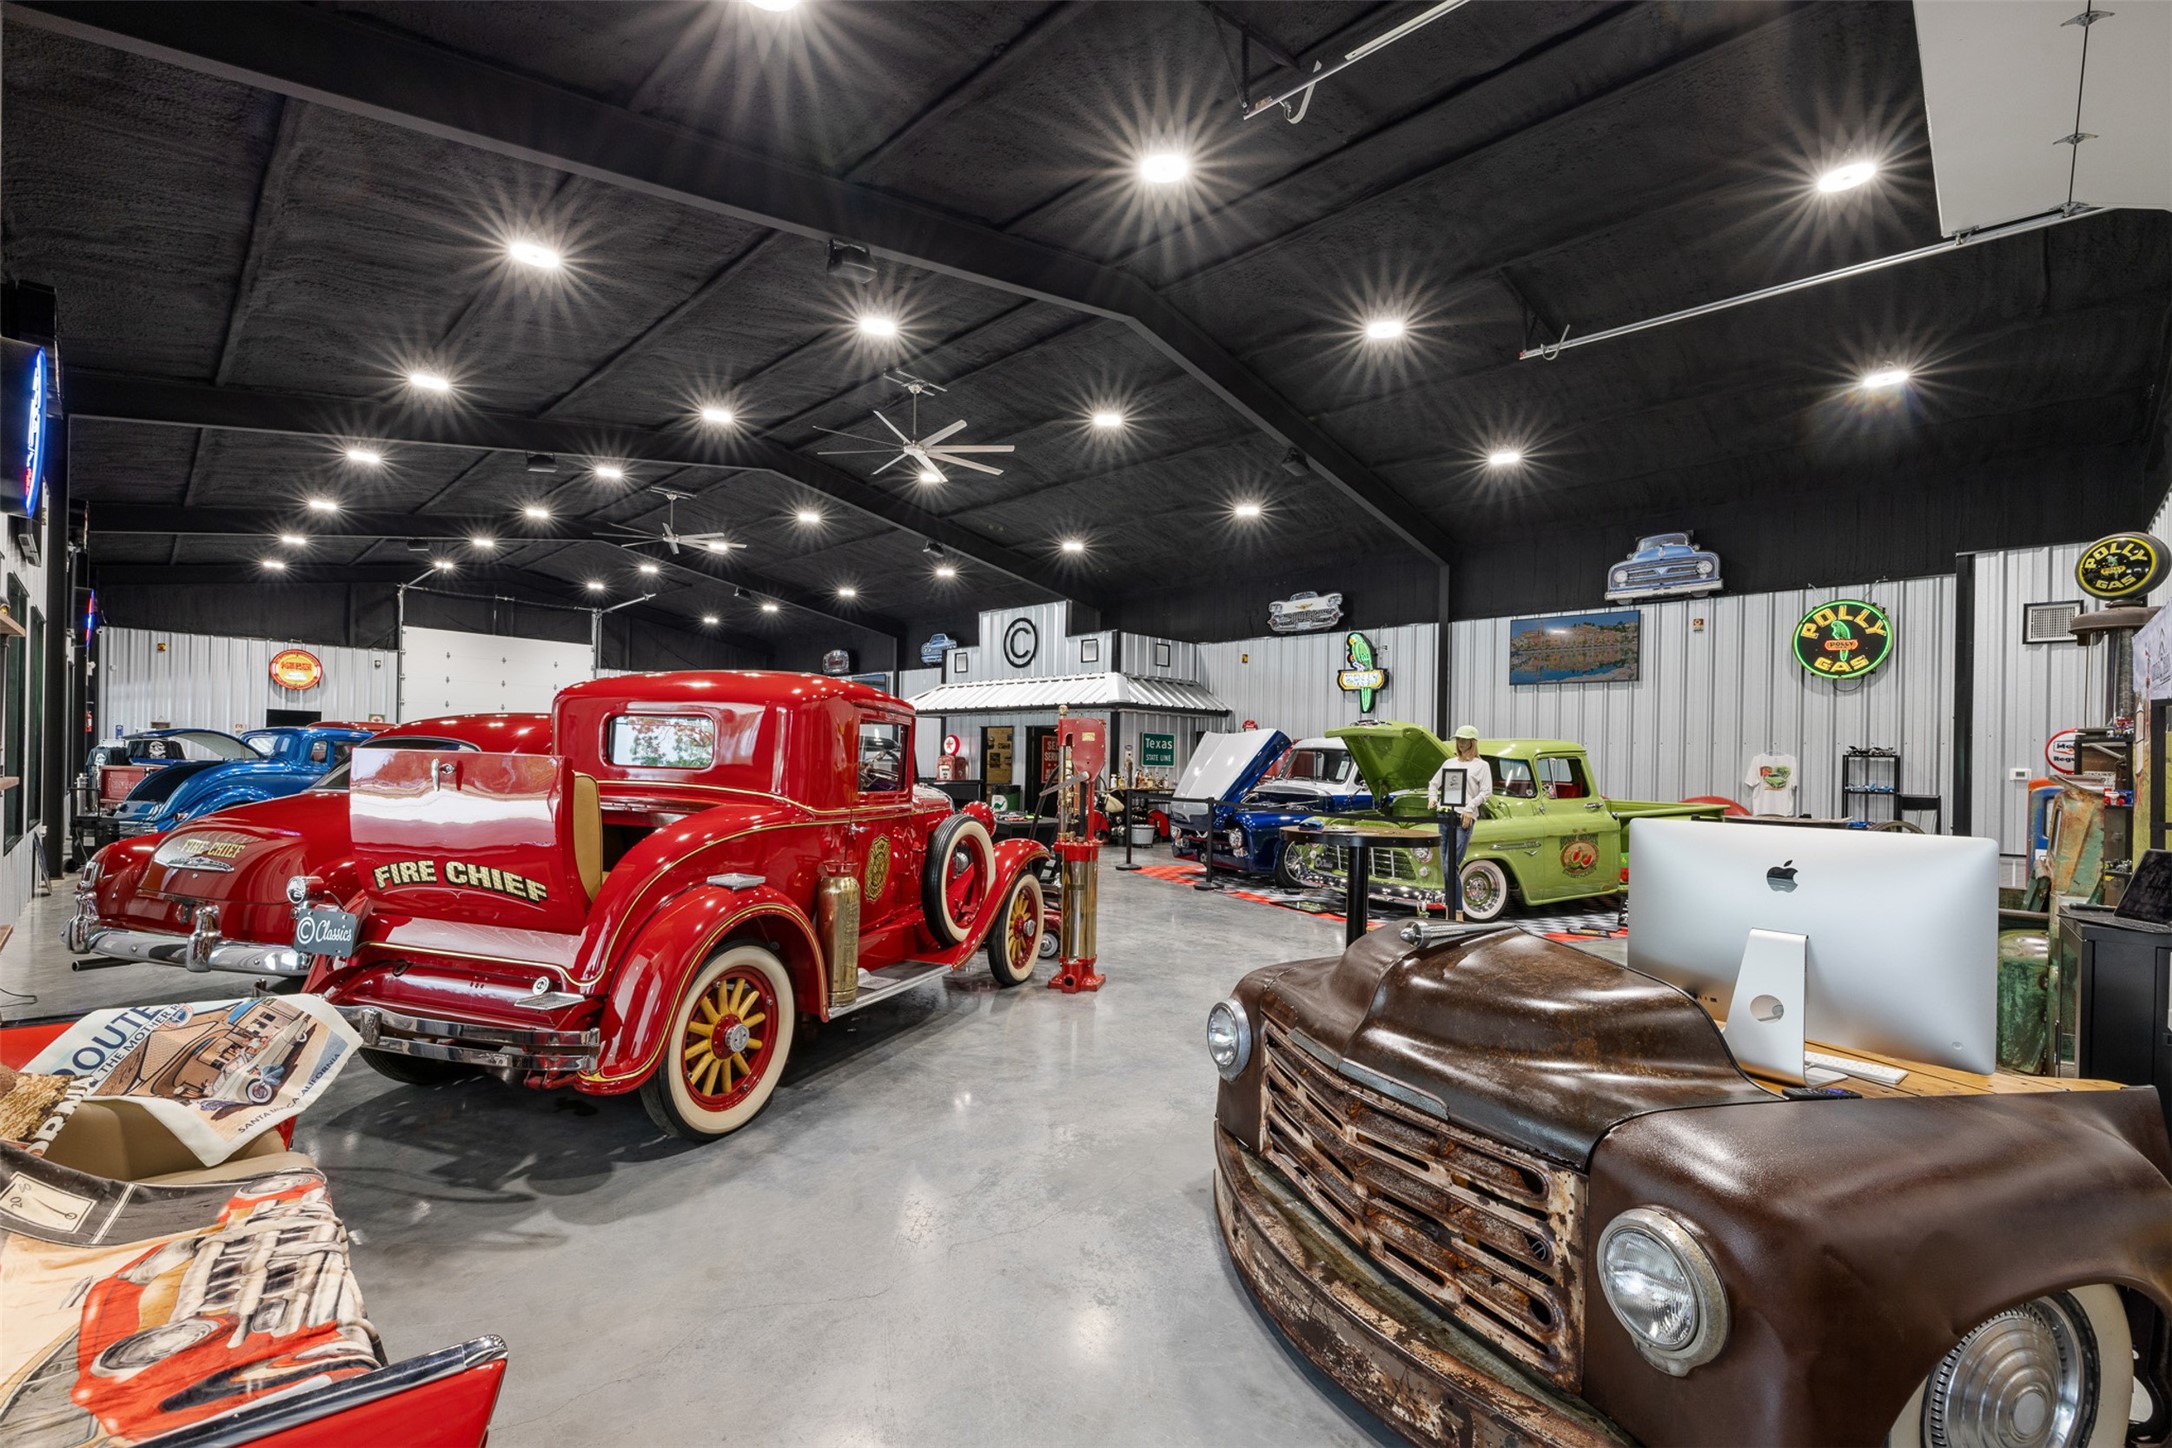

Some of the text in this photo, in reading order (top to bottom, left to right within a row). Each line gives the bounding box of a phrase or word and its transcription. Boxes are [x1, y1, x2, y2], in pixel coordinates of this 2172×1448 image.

[2085, 543, 2148, 568] POLLY
[2095, 574, 2136, 590] GAS
[1801, 605, 1887, 639] POLLY
[1814, 655, 1869, 672] GAS
[1145, 738, 1173, 750] Texas
[180, 838, 246, 859] FIRE CHIEF
[373, 860, 548, 903] FIRE CHIEF
[315, 919, 352, 942] Classics
[98, 1010, 171, 1076] THE MOTHER
[238, 1109, 272, 1134] SANTA
